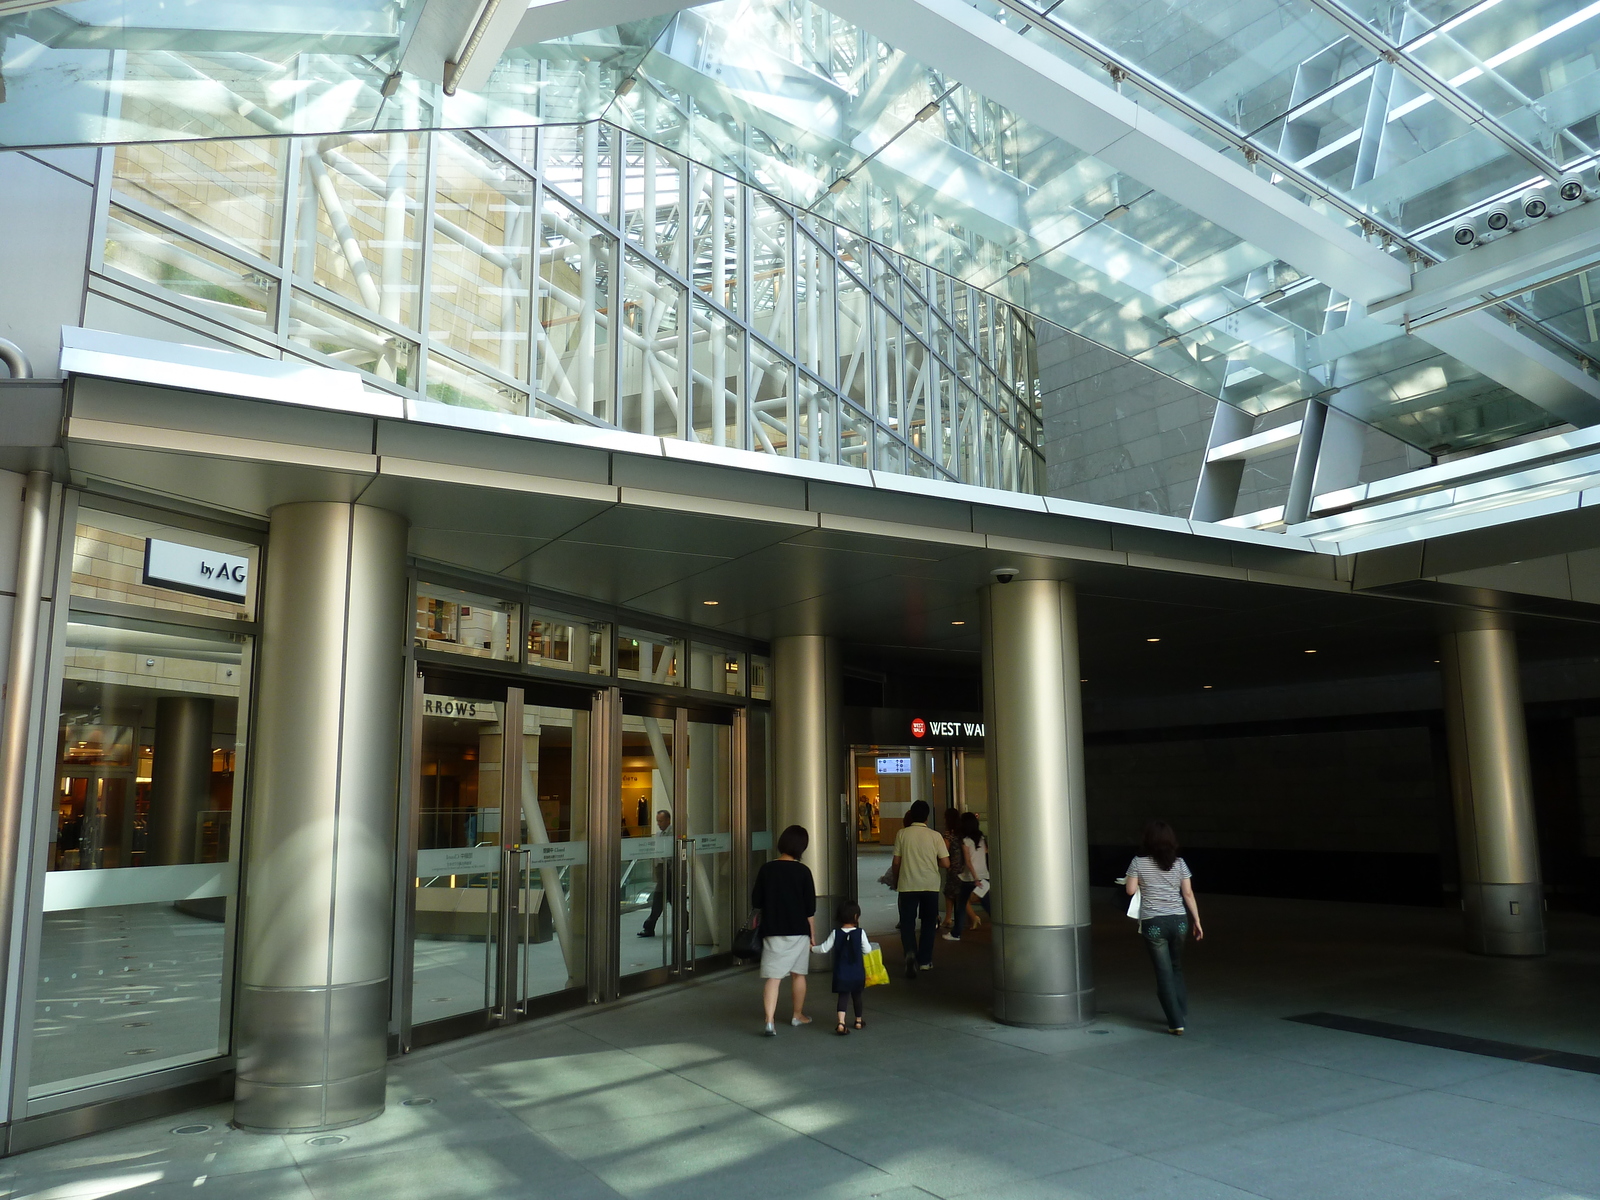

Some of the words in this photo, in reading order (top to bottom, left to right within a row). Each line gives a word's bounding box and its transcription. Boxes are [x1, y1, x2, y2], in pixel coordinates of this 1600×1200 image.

[200, 561, 215, 579] by
[216, 562, 246, 583] AG
[425, 699, 476, 717] RROWS
[929, 721, 961, 736] WEST
